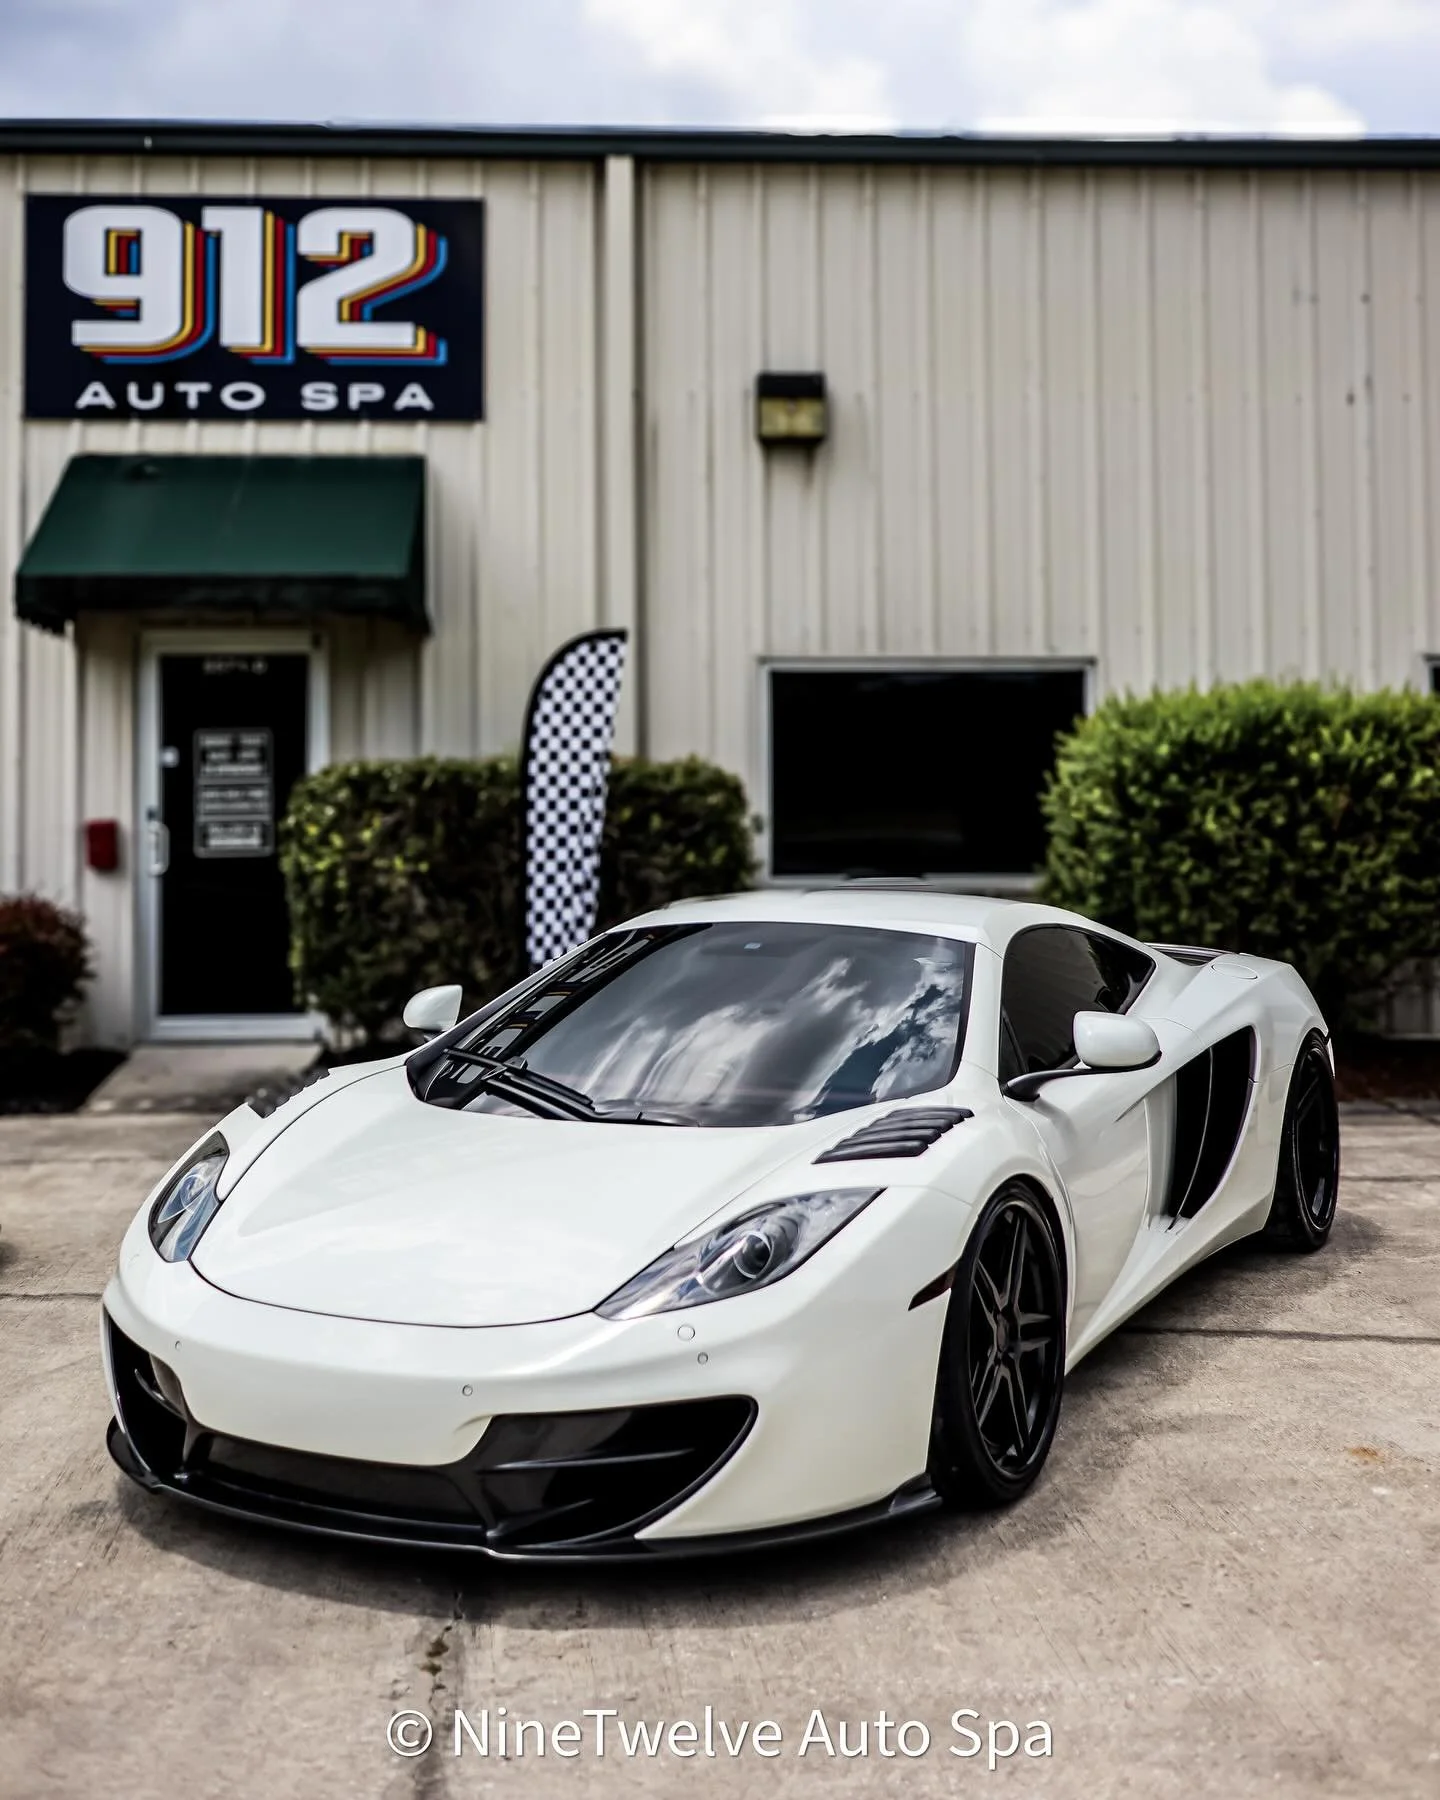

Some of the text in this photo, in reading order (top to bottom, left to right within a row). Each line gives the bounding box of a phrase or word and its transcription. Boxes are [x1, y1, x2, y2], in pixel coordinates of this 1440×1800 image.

[63, 205, 448, 366] 912
[75, 381, 434, 411] AUTO SPA
